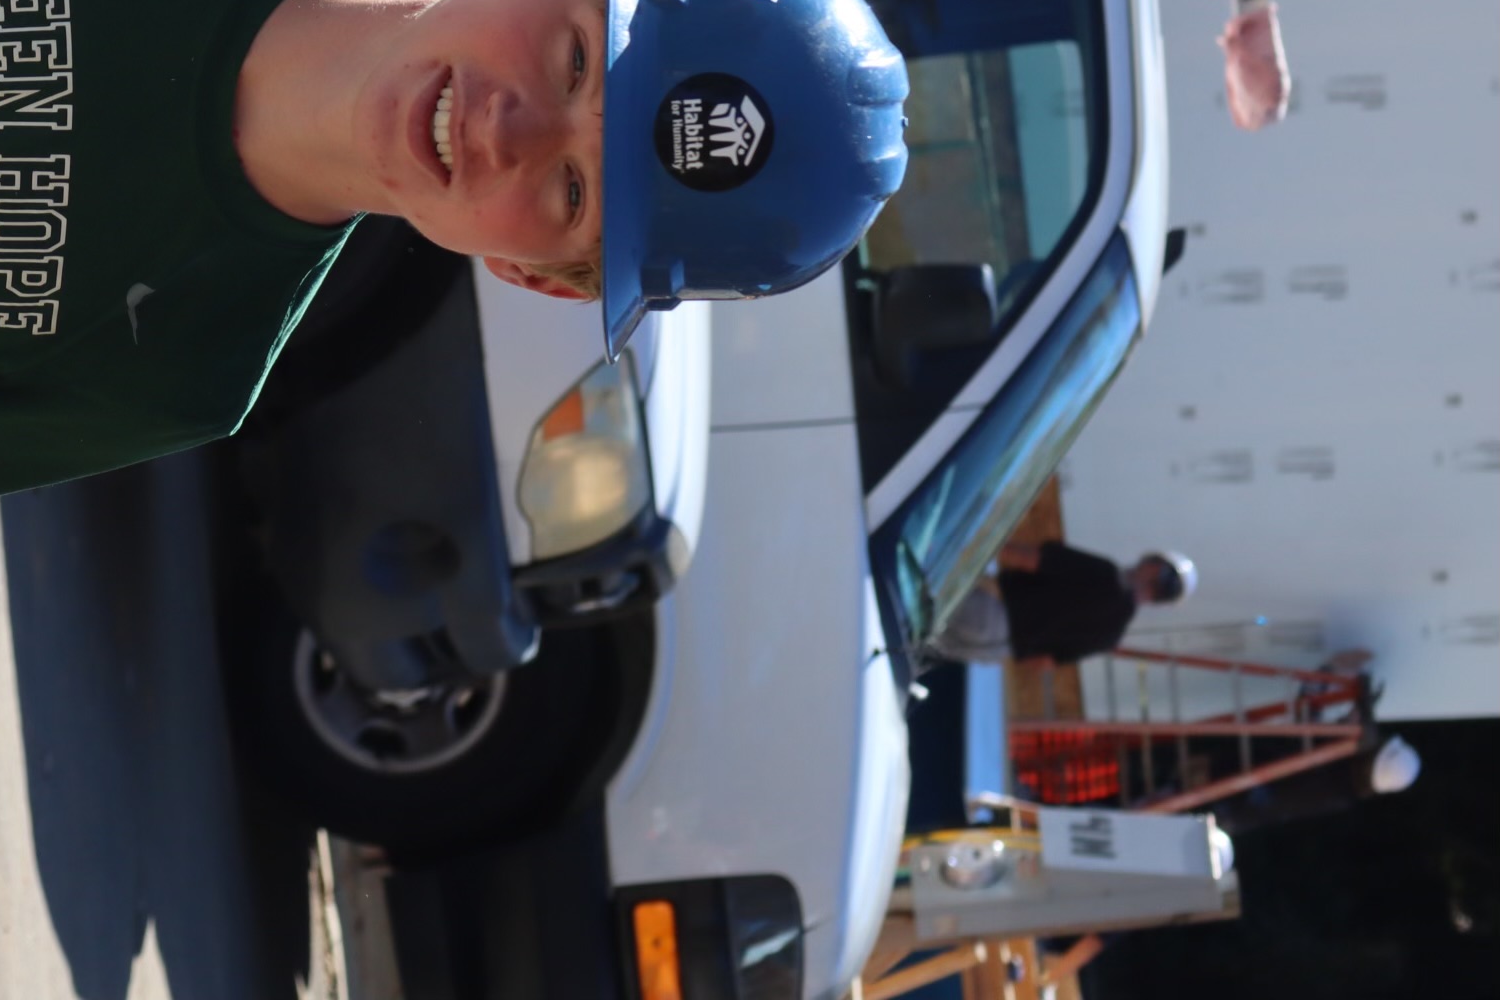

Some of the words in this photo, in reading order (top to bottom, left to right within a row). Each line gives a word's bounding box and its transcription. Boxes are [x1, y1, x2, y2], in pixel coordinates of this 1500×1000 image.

[670, 100, 682, 116] for
[671, 119, 685, 170] Humanity
[683, 98, 704, 170] Habitat
